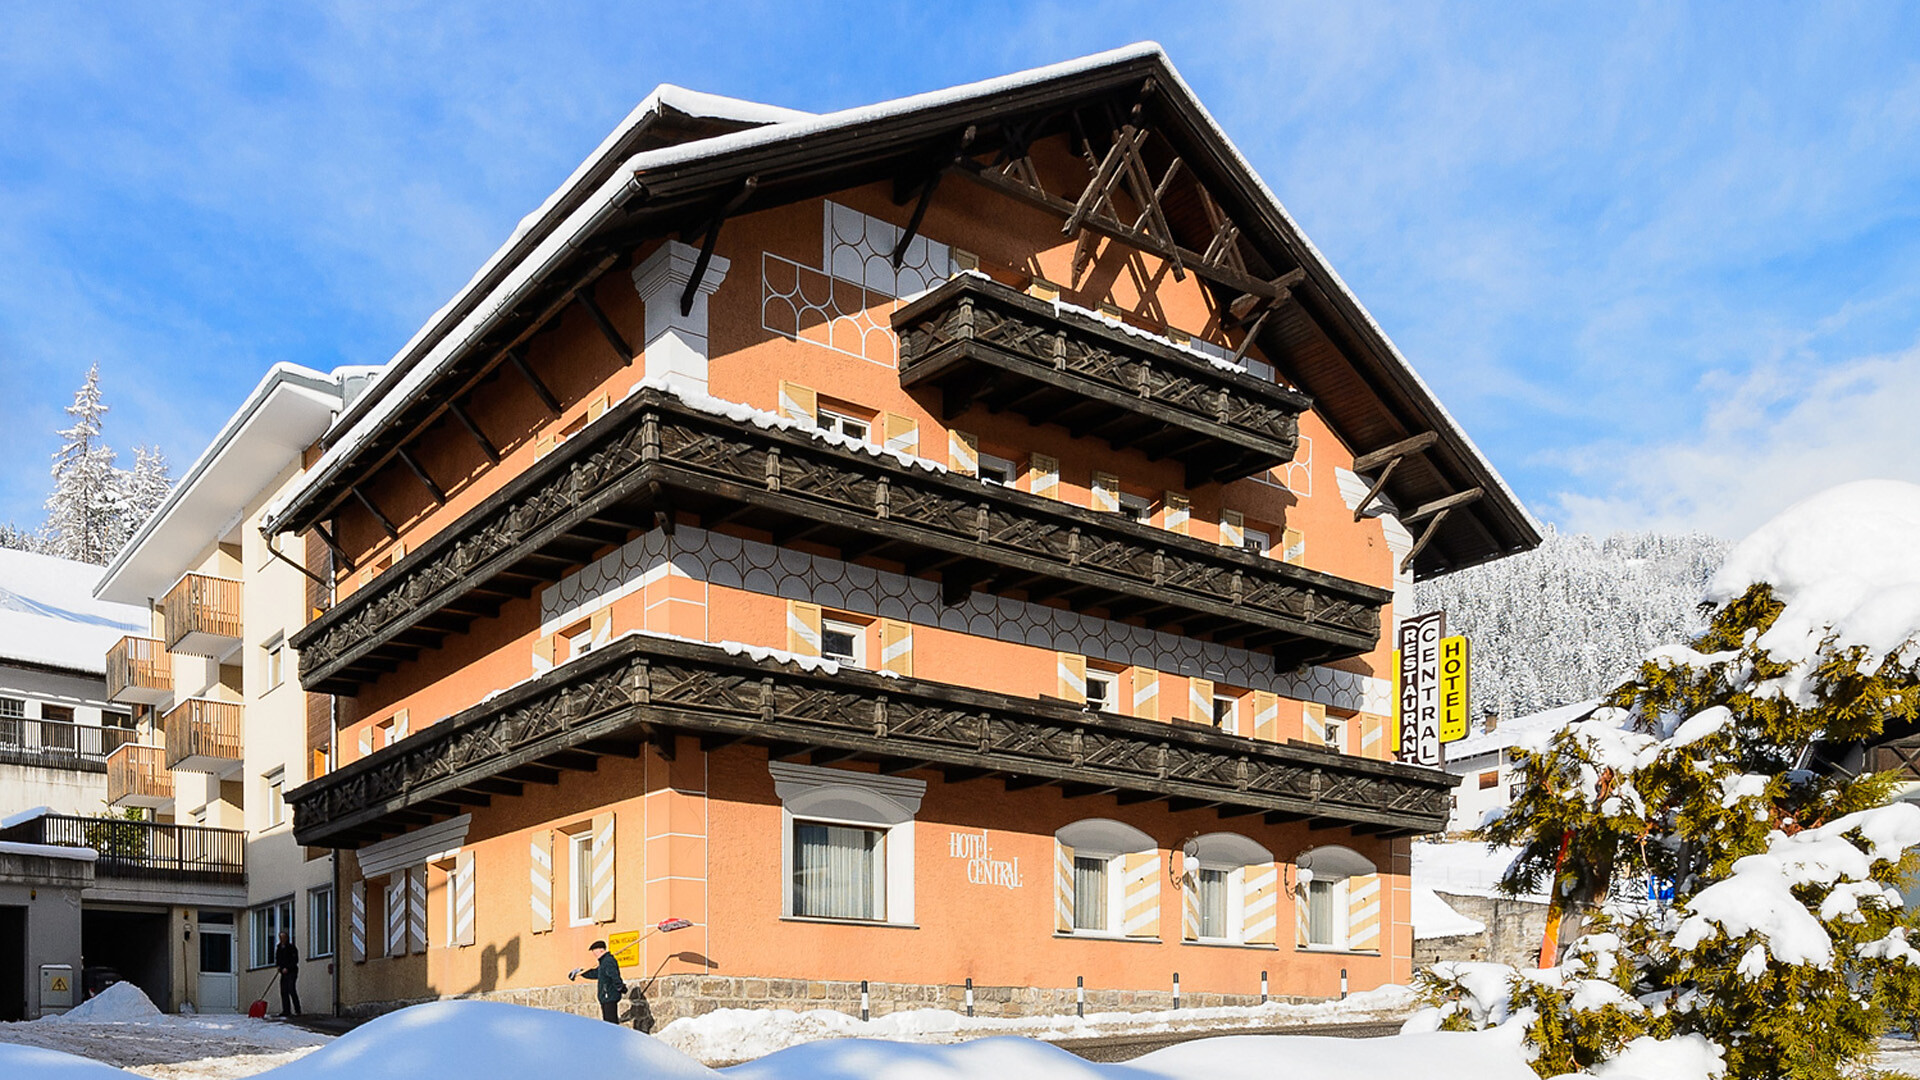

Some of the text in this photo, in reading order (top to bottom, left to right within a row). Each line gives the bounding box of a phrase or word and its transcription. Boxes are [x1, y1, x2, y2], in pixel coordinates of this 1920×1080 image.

[1403, 629, 1417, 765] RESTAURANT
[1421, 628, 1436, 759] CENTRAL
[1444, 642, 1461, 723] HOTEL
